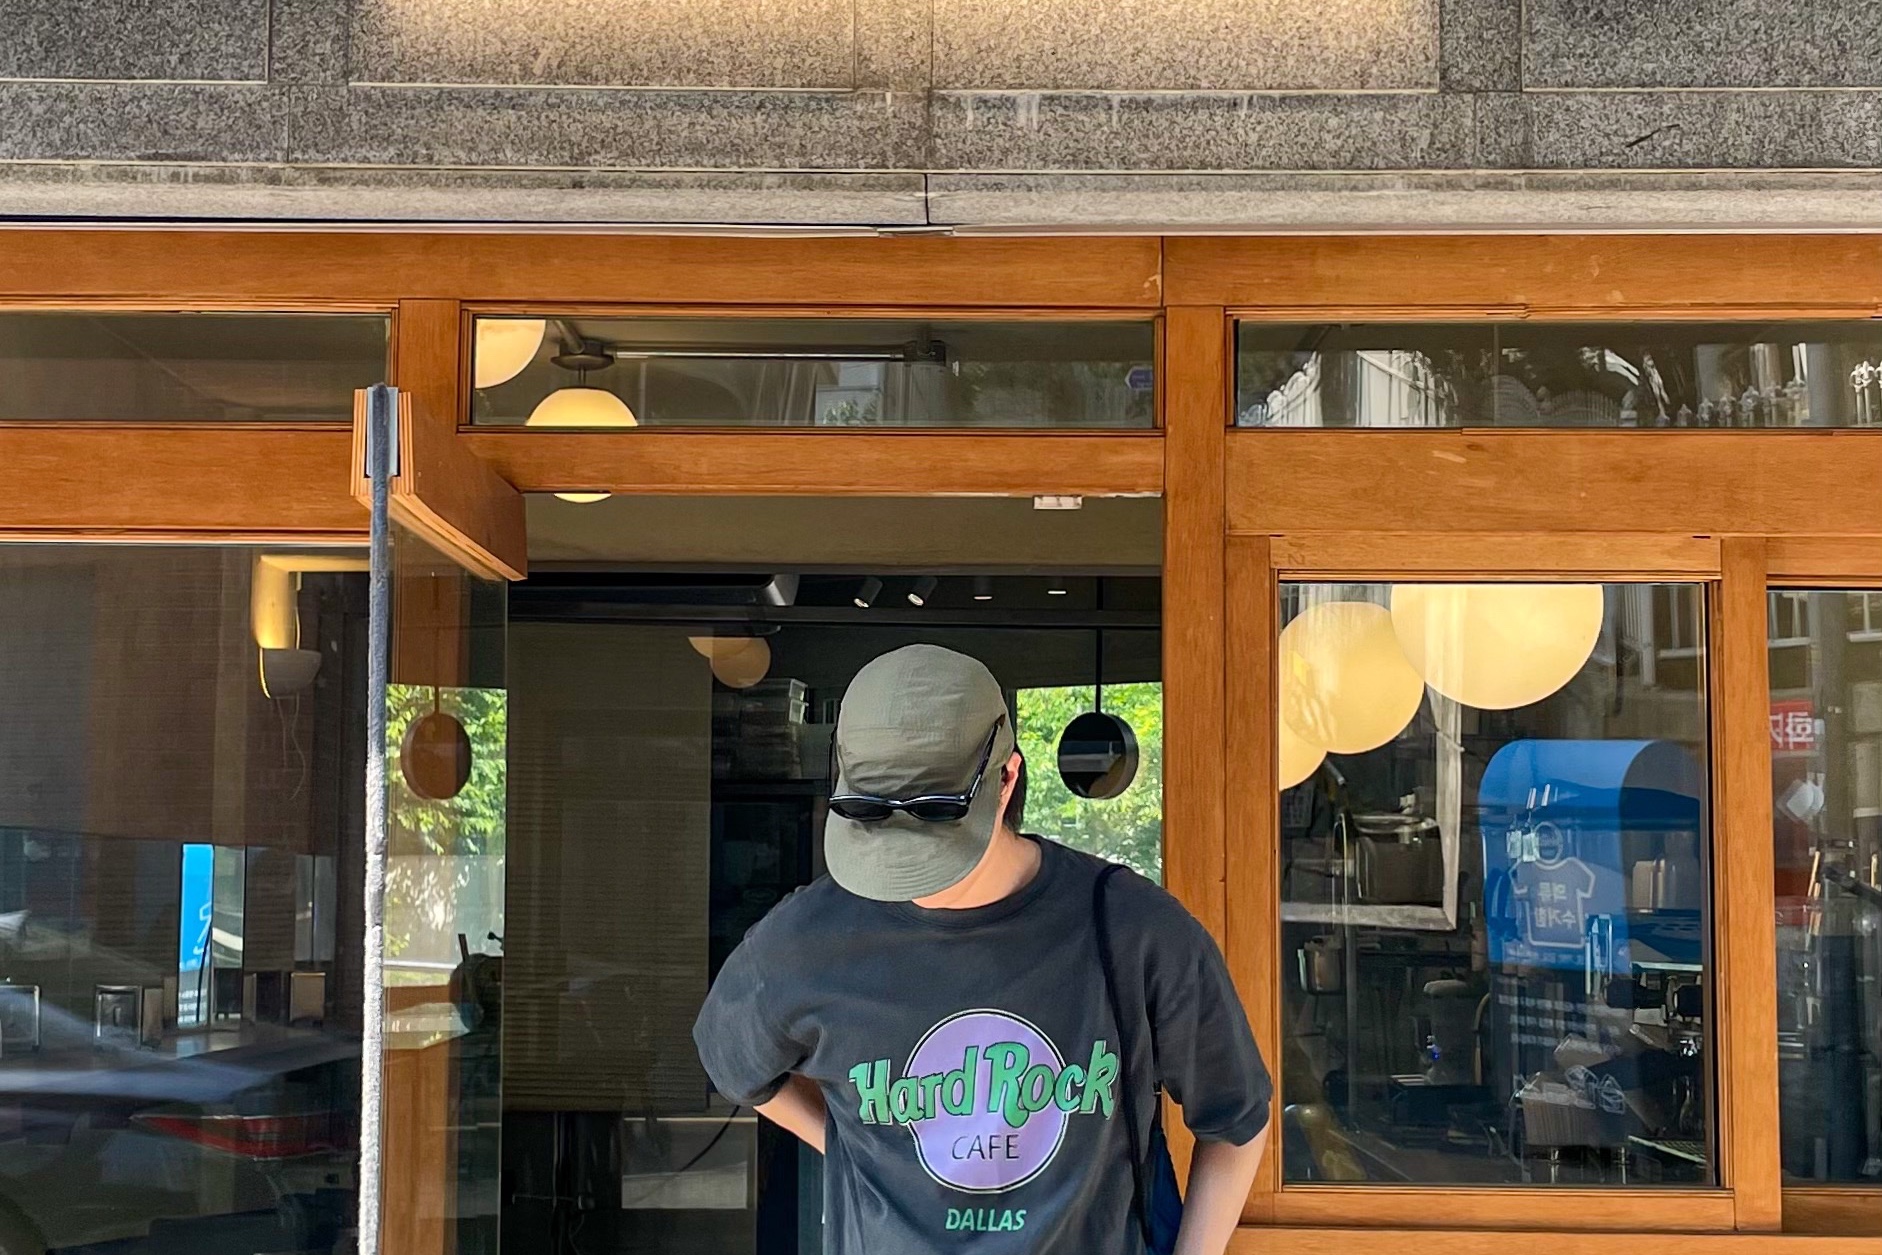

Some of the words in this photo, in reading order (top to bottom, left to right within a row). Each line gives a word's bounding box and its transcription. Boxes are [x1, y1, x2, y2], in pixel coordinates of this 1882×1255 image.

[849, 1045, 979, 1126] Hard
[984, 1039, 1120, 1129] Rock
[951, 1134, 1020, 1160] CAFE
[945, 1207, 1027, 1231] DALLAS
